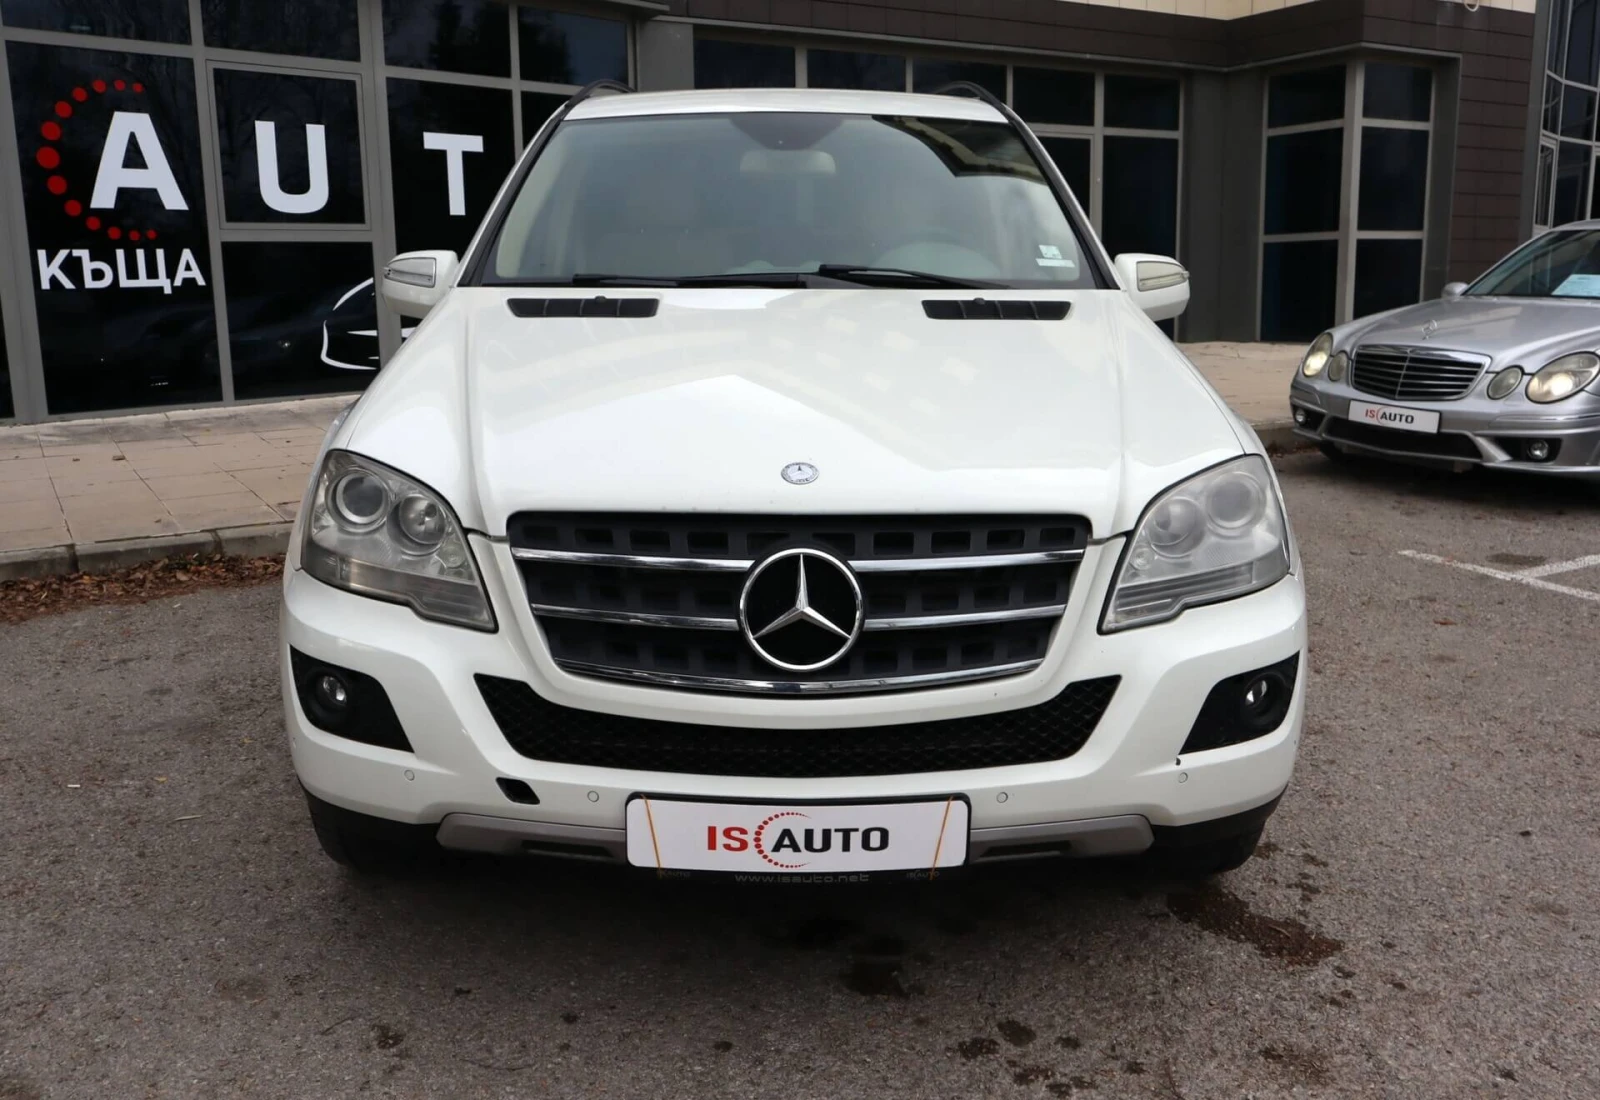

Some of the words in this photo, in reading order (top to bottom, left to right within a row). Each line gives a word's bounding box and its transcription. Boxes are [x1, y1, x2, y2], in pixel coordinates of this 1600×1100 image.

[37, 247, 206, 294] КЪЩА
[1380, 412, 1414, 424] AUTO
[771, 826, 889, 853] AUTO
[735, 872, 870, 883] www.isauto.net
